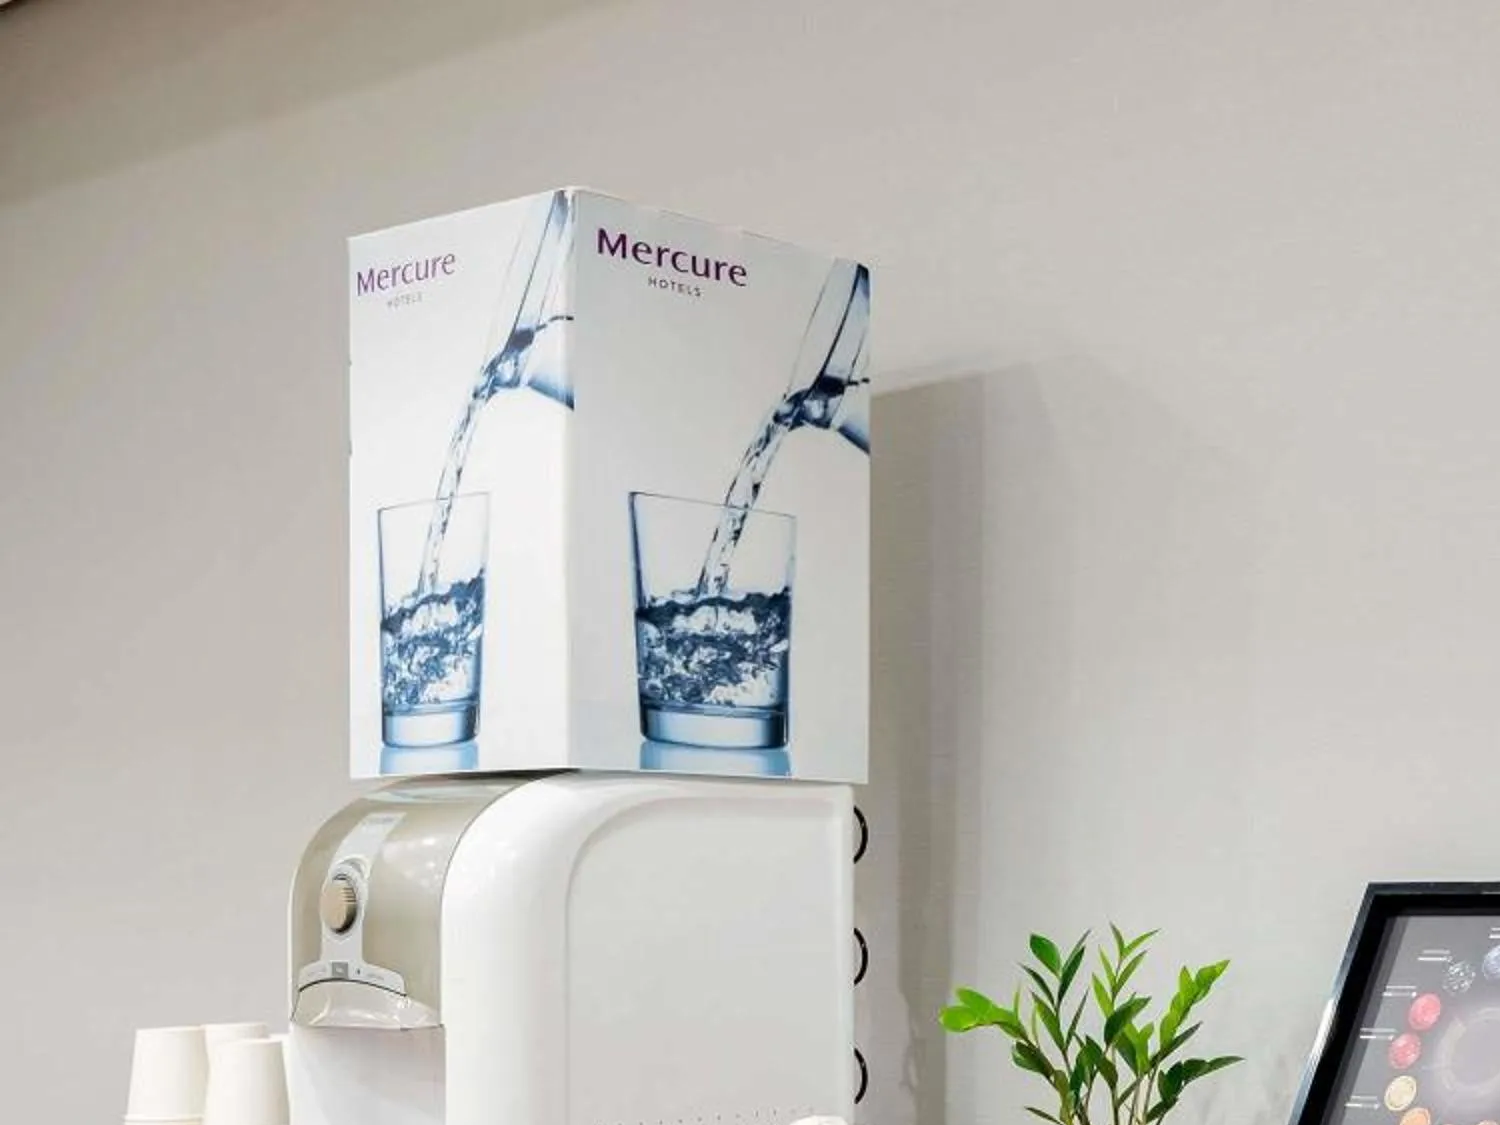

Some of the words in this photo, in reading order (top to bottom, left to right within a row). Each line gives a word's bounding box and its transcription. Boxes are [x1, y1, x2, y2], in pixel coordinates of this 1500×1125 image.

[356, 253, 456, 297] Mercure
[597, 227, 748, 287] Mercure
[647, 276, 703, 298] HOTELS
